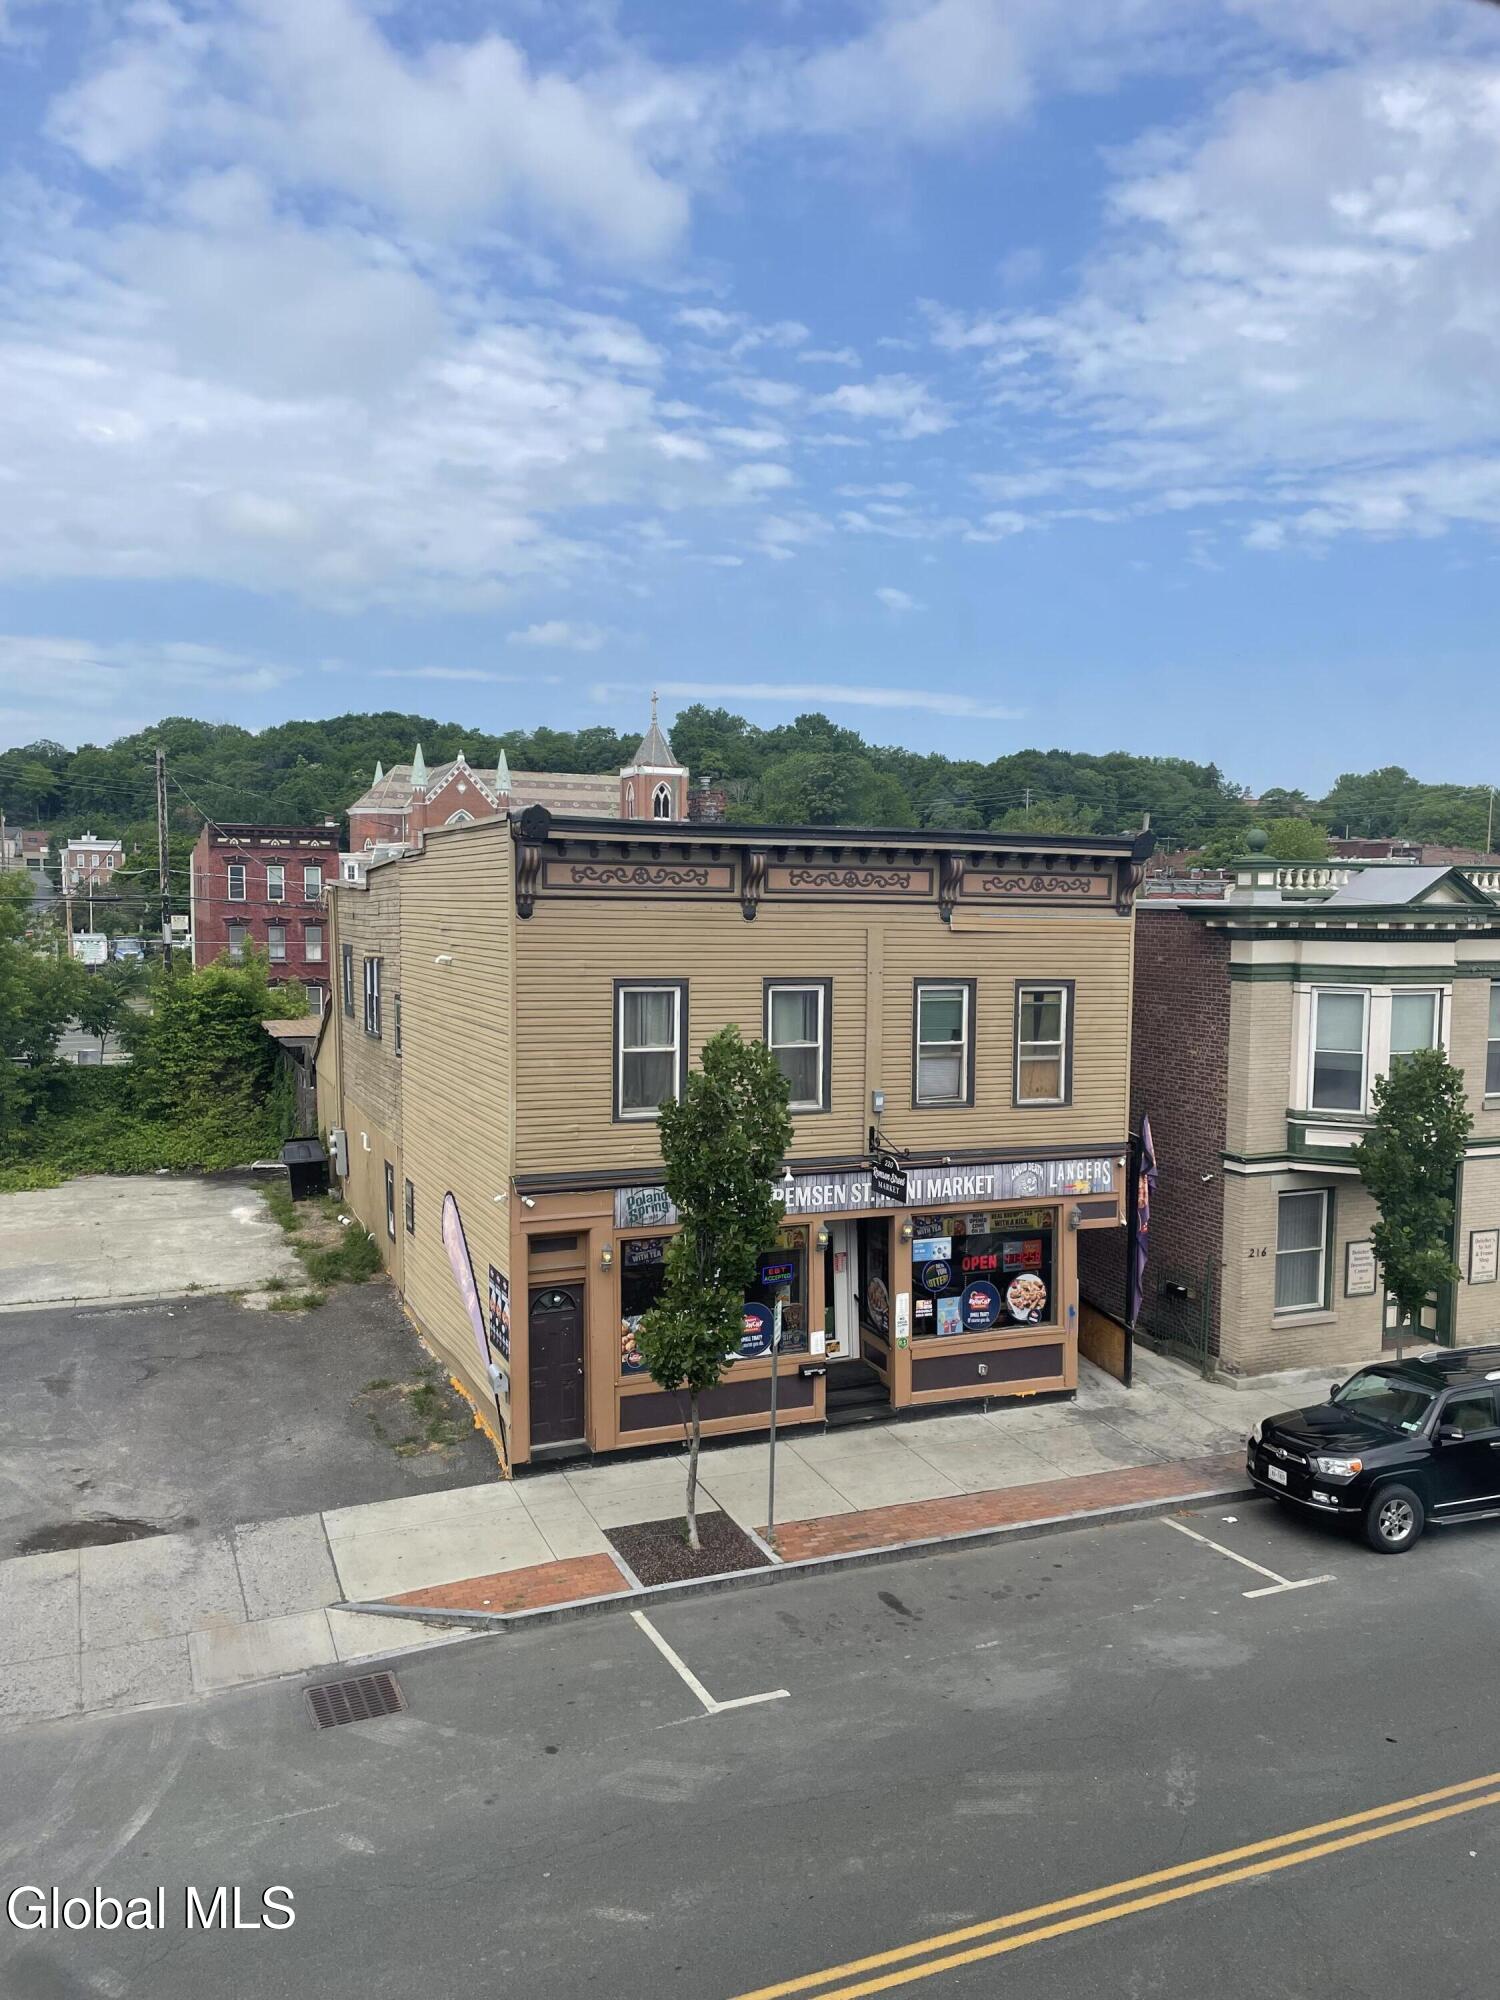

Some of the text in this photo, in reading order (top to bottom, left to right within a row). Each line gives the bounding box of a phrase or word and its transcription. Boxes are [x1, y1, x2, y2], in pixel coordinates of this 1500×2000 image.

[885, 1160, 894, 1168] 220
[1049, 1161, 1111, 1187] LANGERS
[851, 1183, 875, 1202] ST.
[927, 1175, 994, 1198] MARKET
[878, 1180, 899, 1194] MARKET
[627, 1191, 668, 1210] Poland
[629, 1201, 670, 1223] Spring
[1248, 1247, 1267, 1258] 216
[962, 1254, 998, 1271] OPEN
[764, 1272, 792, 1281] ACCEPTED
[768, 1266, 786, 1275] EBT
